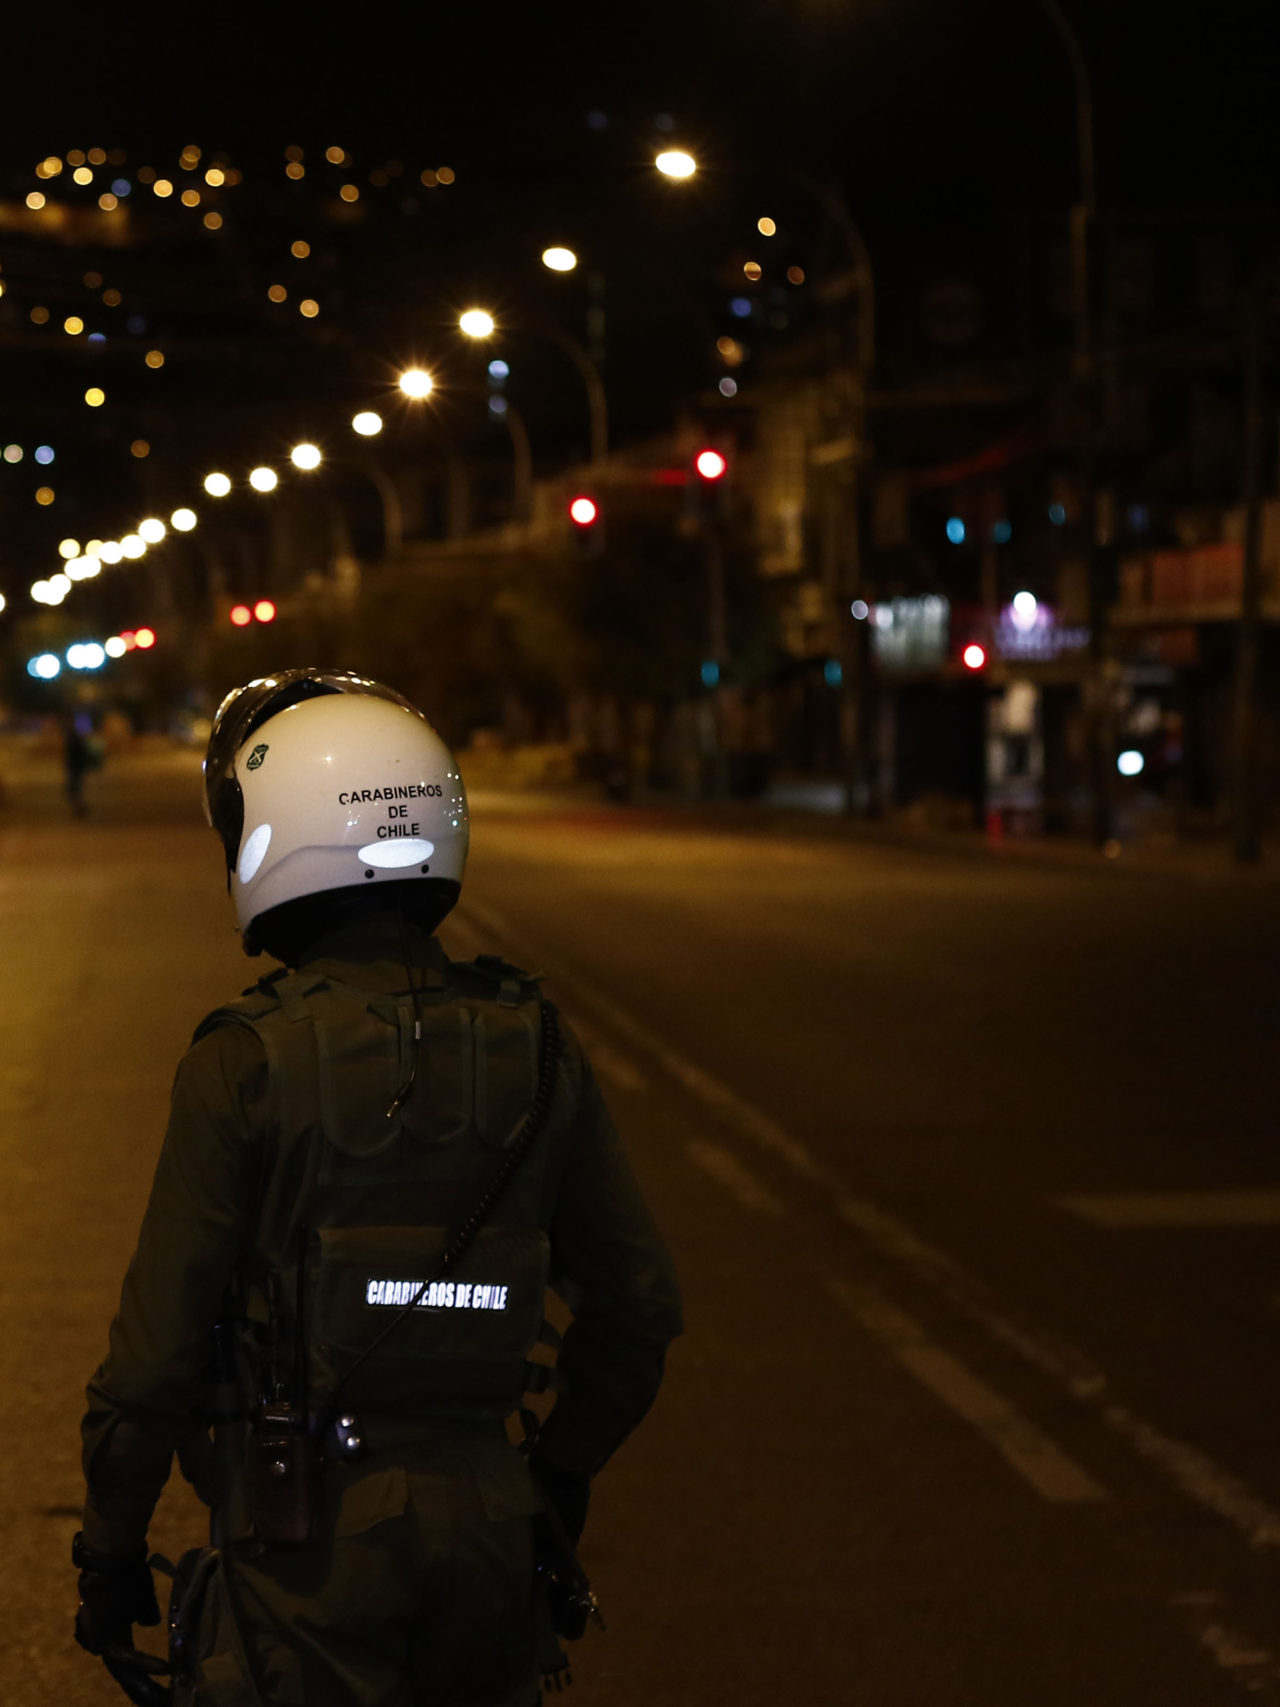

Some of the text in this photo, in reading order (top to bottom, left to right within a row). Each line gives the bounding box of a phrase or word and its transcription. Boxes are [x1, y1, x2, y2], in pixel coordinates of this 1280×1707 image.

[339, 785, 442, 805] CARABINEROS
[388, 805, 408, 819] DE
[377, 823, 420, 838] CHILE
[455, 1284, 472, 1308] DE
[472, 1285, 507, 1310] CHILE
